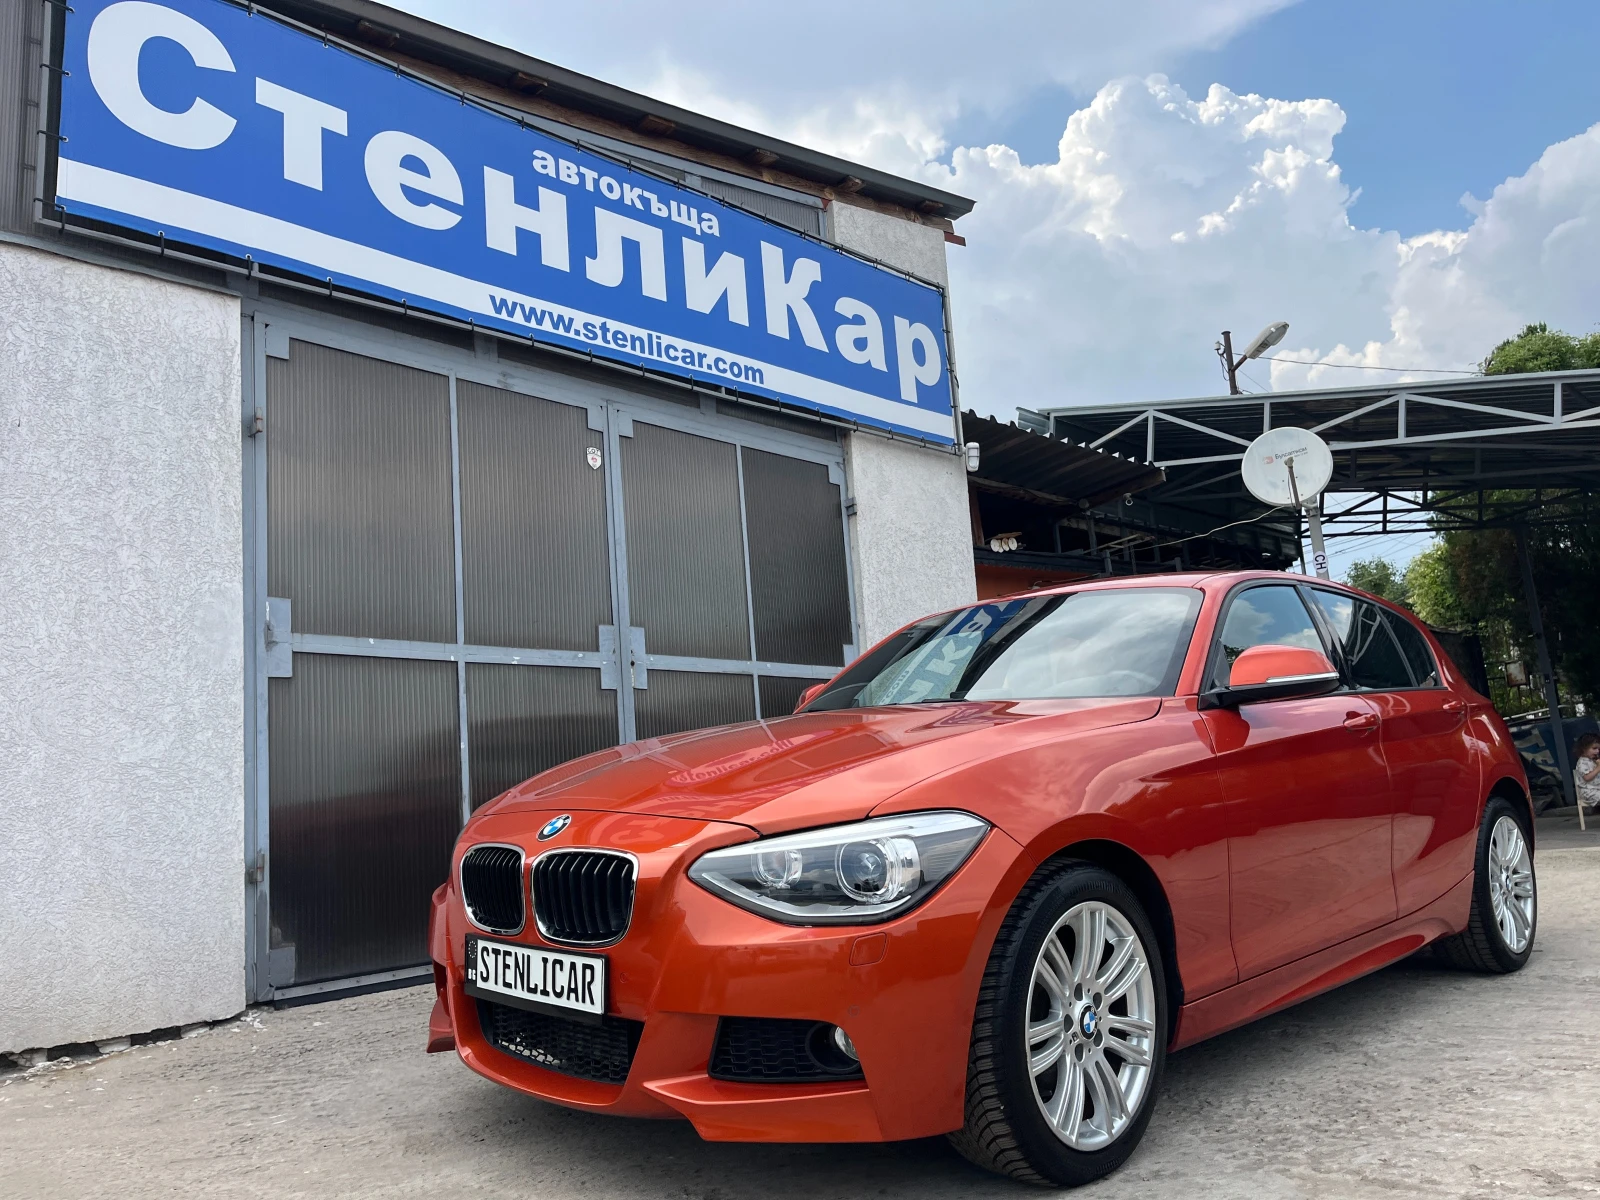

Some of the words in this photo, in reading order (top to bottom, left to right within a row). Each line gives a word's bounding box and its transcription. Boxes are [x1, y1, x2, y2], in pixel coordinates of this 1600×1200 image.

[87, 0, 942, 404] СтенлиКар
[532, 149, 721, 237] автокъща
[489, 294, 765, 386] www.stenlicar.com
[1315, 554, 1327, 570] CH
[479, 945, 595, 1005] STENLICAR
